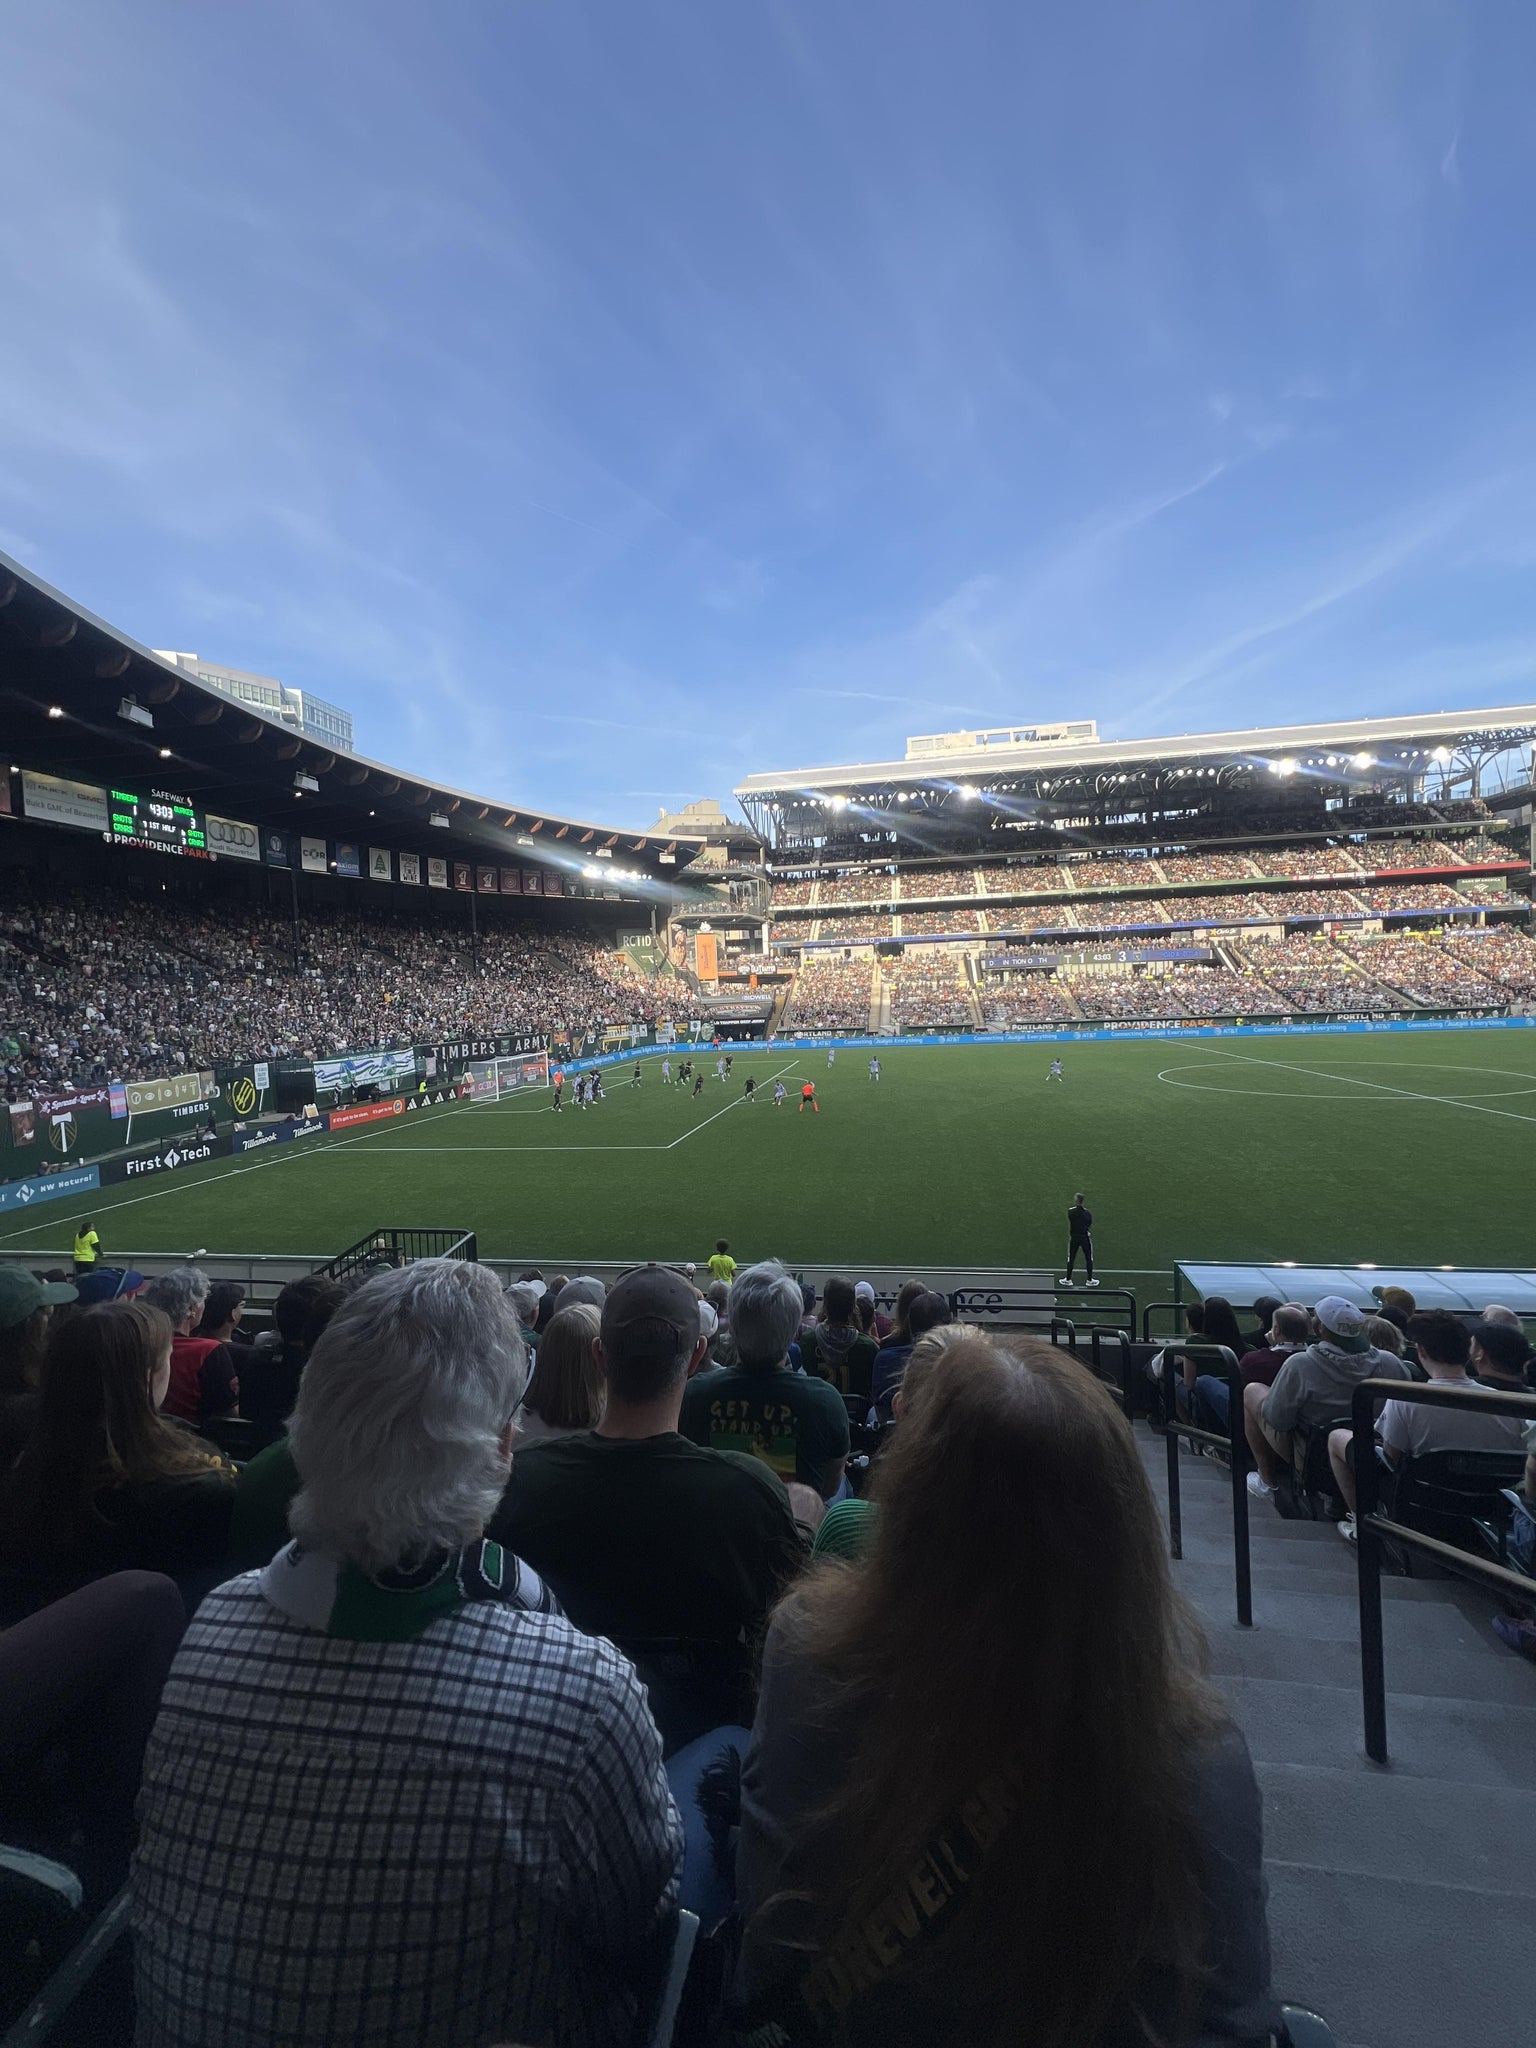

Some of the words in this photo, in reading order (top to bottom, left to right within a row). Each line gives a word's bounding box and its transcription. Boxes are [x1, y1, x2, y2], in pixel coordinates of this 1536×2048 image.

[151, 789, 184, 803] SAFEWAY
[149, 803, 173, 819] 43:03
[112, 813, 132, 824] SHOTS
[190, 817, 196, 829] 3
[187, 829, 204, 839] SHOTS
[623, 935, 652, 947] RCTID
[1119, 951, 1127, 962] 3
[1337, 1012, 1385, 1021] PORTLND
[1012, 1022, 1054, 1030] PORTLAND
[432, 1042, 495, 1060] TIMBERS
[515, 1034, 549, 1052] ARMY
[173, 1103, 210, 1118] TIMBERS
[293, 1121, 323, 1138] Tillamook
[242, 1132, 277, 1150] Tillamook
[126, 1155, 161, 1175] First
[181, 1145, 210, 1162] Tech
[40, 1183, 55, 1193] NW
[58, 1173, 92, 1188] Natural
[710, 1400, 749, 1418] GET
[711, 1420, 762, 1434] STAND
